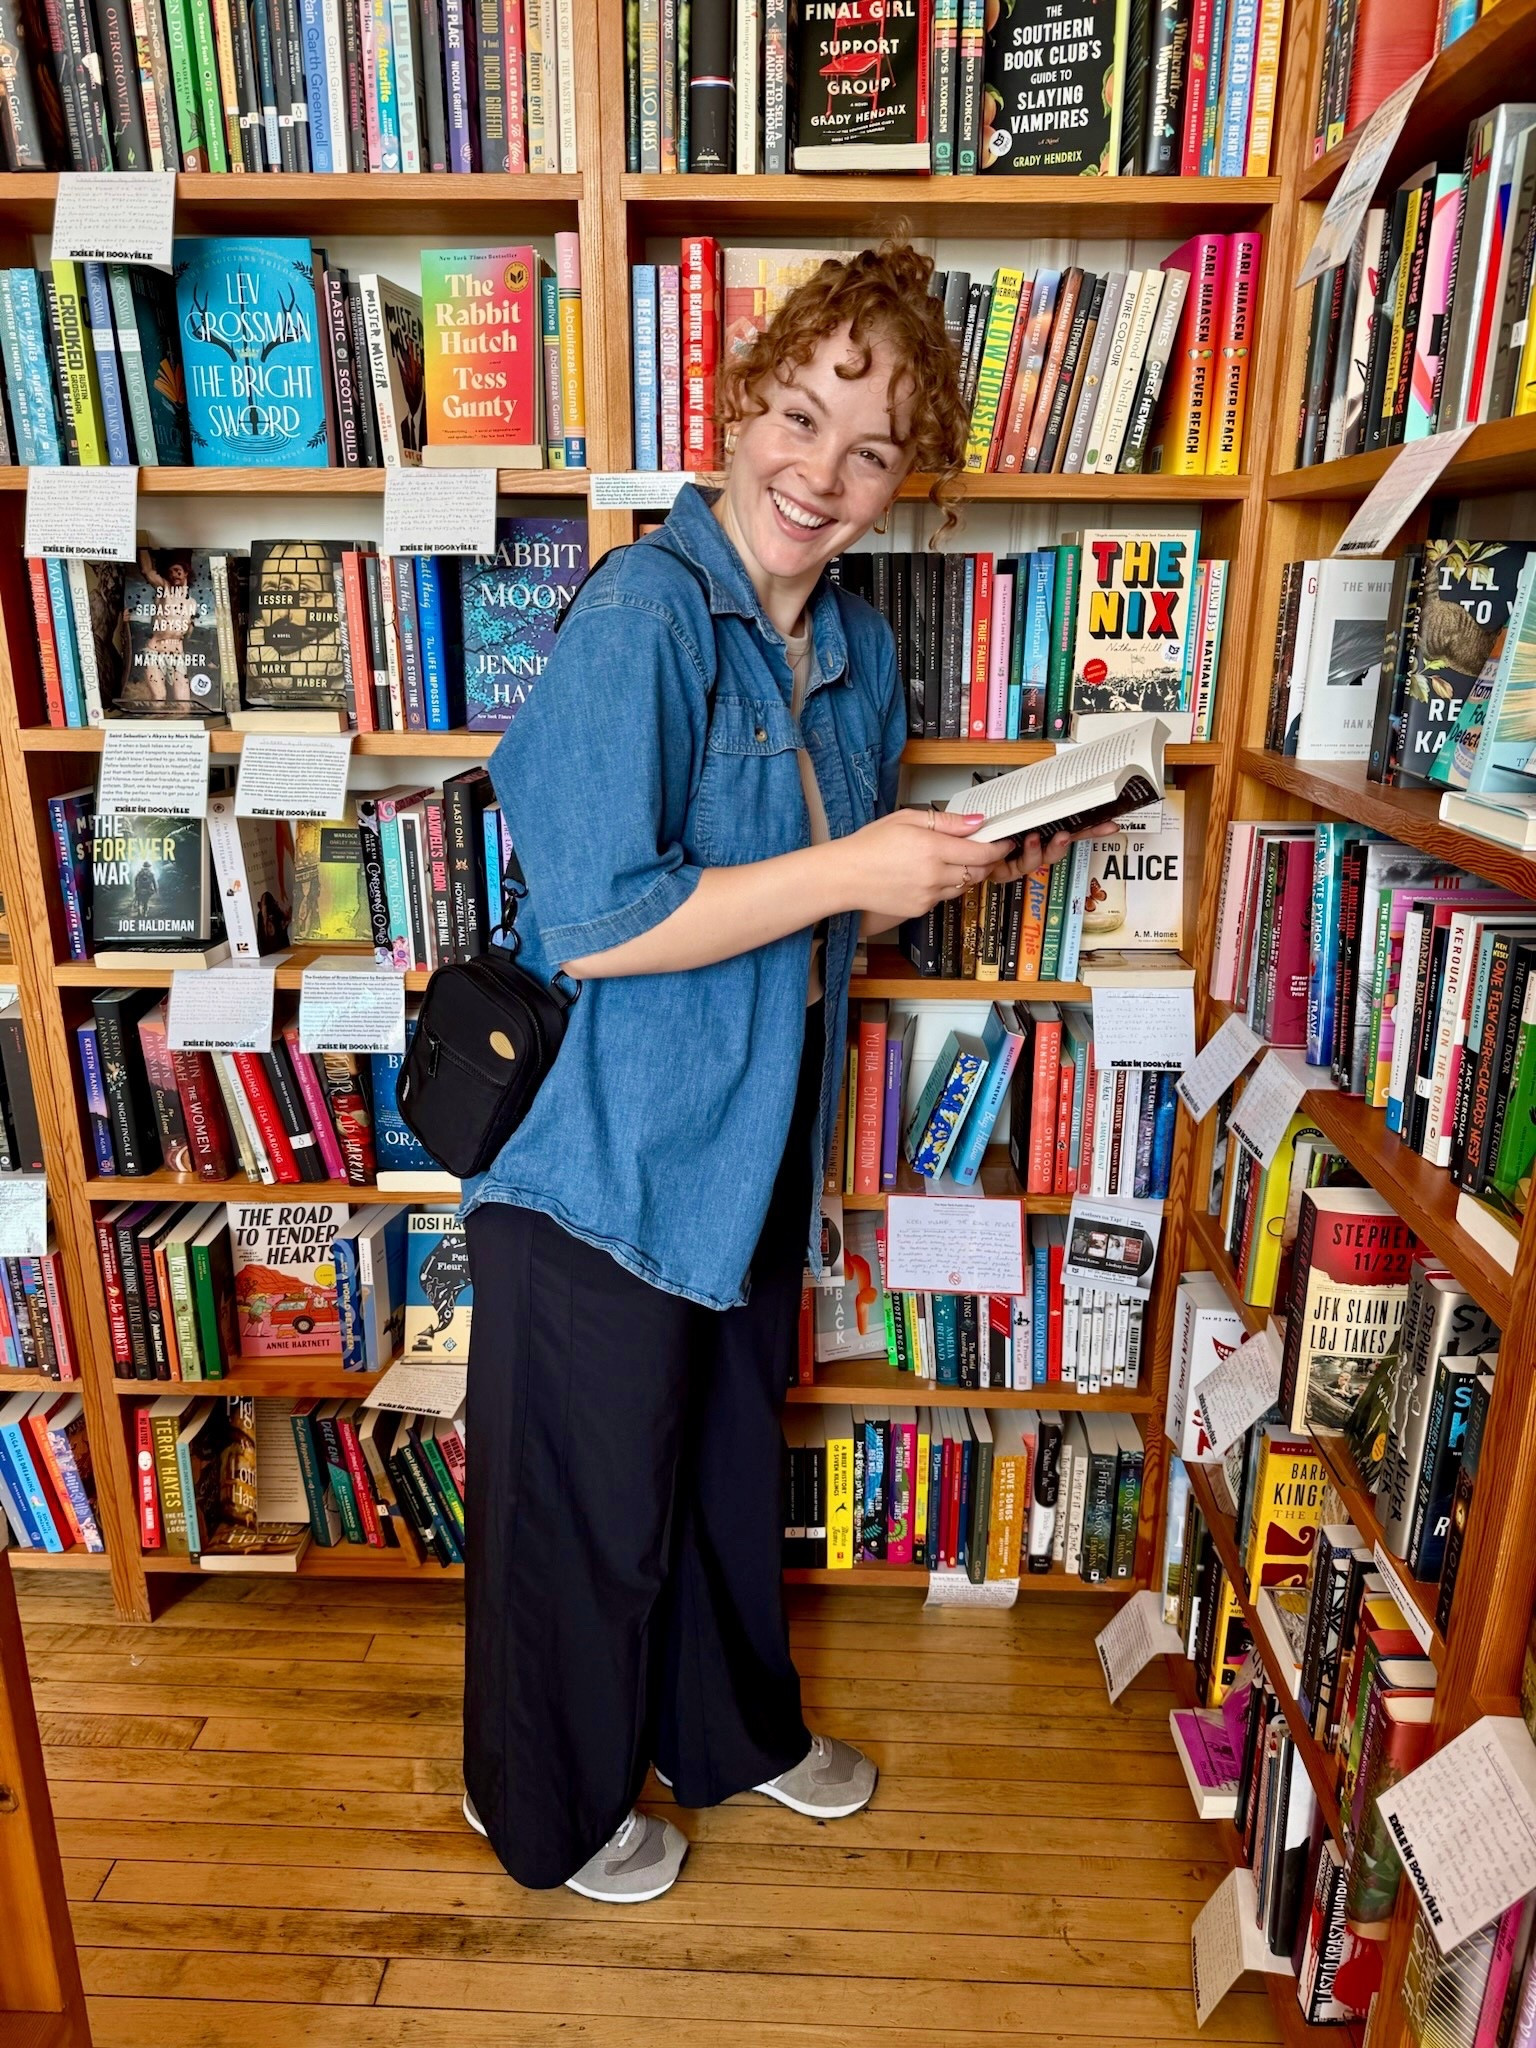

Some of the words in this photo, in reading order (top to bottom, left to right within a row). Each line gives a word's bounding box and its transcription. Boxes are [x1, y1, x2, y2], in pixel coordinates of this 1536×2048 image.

[805, 4, 862, 21] FINAL
[869, 1, 916, 18] GIRL
[1046, 5, 1063, 17] THE
[642, 22, 657, 41] THE
[1013, 16, 1095, 47] SOUTHERN
[308, 27, 320, 68] Garth
[642, 47, 657, 73] SUN
[819, 39, 899, 56] SUPPORT
[1004, 46, 1043, 71] BOOK
[1049, 39, 1102, 65] CLUB'S
[106, 7, 131, 125] OVERGROWTH
[767, 45, 776, 105] HAUNTED
[776, 54, 784, 80] HOW
[1031, 71, 1057, 85] GUIDE
[1060, 69, 1072, 82] TO
[642, 77, 657, 116] ALSO
[776, 83, 784, 99] TO
[826, 78, 891, 96] GROUP
[1017, 85, 1083, 111] SLAYING
[310, 70, 328, 148] Greenwell
[775, 105, 784, 129] SELL
[810, 113, 850, 127] GRADY
[855, 104, 906, 124] HENDRIX
[1010, 108, 1089, 135] VAMPIRES
[642, 120, 657, 151] RISES
[766, 108, 776, 149] HOUSE
[1013, 154, 1041, 168] GRADY
[1044, 150, 1082, 165] HENDRIX
[689, 243, 702, 272] GREAT
[1238, 242, 1253, 279] CARL
[226, 272, 260, 305] LEV
[444, 274, 494, 298] The
[689, 274, 702, 290] BIG
[1170, 278, 1182, 296] NO
[330, 280, 346, 342] PLASTIC
[434, 300, 522, 327] Rabbit
[689, 292, 702, 340] BEAUTIFUL
[1157, 299, 1179, 347] NAMES
[1231, 281, 1249, 342] HIAASEN
[59, 294, 84, 370] CROOKED
[184, 311, 311, 343] GROSSMAN
[985, 301, 1016, 363] SLOW
[440, 331, 518, 356] Hutch
[690, 344, 703, 363] LIFE
[192, 366, 224, 398] THE
[232, 365, 313, 399] BRIGHT
[452, 367, 507, 390] Tess
[1146, 360, 1162, 394] GREG
[1226, 364, 1241, 407] FEVER
[339, 368, 353, 416] SCOTT
[689, 377, 703, 411] EMILY
[442, 394, 518, 423] Gunty
[968, 366, 1003, 447] HORSES
[208, 405, 300, 438] SWORD
[689, 415, 704, 451] HENRY
[1131, 395, 1154, 448] HEWETT
[1220, 410, 1237, 453] BEACH
[344, 420, 358, 462] GUILD
[474, 542, 582, 568] RABBIT
[1092, 541, 1187, 588] THE
[156, 586, 190, 599] SAINT
[1342, 581, 1364, 592] THE
[1438, 567, 1500, 590] I'LL
[136, 604, 208, 616] SEBASTIAN'S
[258, 595, 293, 606] LESSER
[481, 584, 576, 609] MOON
[1207, 568, 1222, 632] WELLNESS
[73, 587, 90, 641] STEPHEN
[152, 620, 189, 632] ABYSS
[309, 612, 339, 622] RUINS
[1089, 591, 1179, 639] NIX
[404, 633, 413, 651] HOW
[81, 643, 97, 692] FLORIDA
[134, 654, 166, 667] MARK
[168, 654, 206, 667] HABER
[261, 664, 286, 674] MARK
[406, 654, 415, 664] TO
[1202, 640, 1213, 688] NATHAN
[296, 678, 328, 688] HABER
[407, 666, 417, 686] STOP
[409, 689, 419, 707] TIME
[1198, 688, 1208, 718] HILL
[1343, 719, 1364, 729] HAN
[93, 815, 124, 837] THE
[427, 806, 443, 858] MAXWELL'S
[92, 838, 176, 862] FOREVER
[1102, 842, 1121, 852] END
[1133, 842, 1145, 852] OF
[1319, 833, 1328, 854] THE
[93, 862, 130, 886] WAR
[431, 861, 447, 892] DEMON
[1103, 855, 1178, 881] ALICE
[1315, 858, 1326, 899] WHYTE
[118, 920, 136, 932] JOE
[138, 919, 194, 932] HALDEMAN
[436, 900, 448, 928] STEVEN
[989, 892, 998, 932] PRACTICAL
[440, 929, 449, 946] HALL
[1134, 930, 1141, 938] A.
[1143, 930, 1151, 938] M.
[1154, 930, 1178, 939] Homes
[1313, 904, 1324, 952] PYTHON
[987, 933, 995, 958] MAGIC
[1448, 927, 1464, 994] KEROUAC
[865, 1033, 880, 1047] YU
[1440, 1029, 1450, 1045] ON
[84, 1038, 95, 1070] KRISTIN
[864, 1051, 878, 1072] HUA
[1435, 1054, 1447, 1080] THE
[89, 1072, 101, 1108] HANNAH
[863, 1087, 877, 1109] CITY
[1431, 1085, 1443, 1123] ROAD
[117, 1102, 133, 1157] NIGHTINGALE
[190, 1102, 212, 1154] WOMEN
[257, 1105, 269, 1124] LISA
[264, 1126, 284, 1163] HARDING
[862, 1114, 877, 1127] OF
[861, 1130, 876, 1169] FICTION
[239, 1208, 272, 1226] THE
[278, 1206, 333, 1224] ROAD
[412, 1218, 440, 1230] IOSI
[236, 1228, 259, 1246] TO
[266, 1225, 339, 1246] TENDER
[266, 1245, 335, 1264] HEARTS
[437, 1262, 462, 1271] Fleur
[170, 1256, 188, 1300] WEYWARD
[1313, 1296, 1341, 1320] JFK
[1346, 1299, 1388, 1324] SLAIN
[1179, 1302, 1191, 1356] STEPHEN
[1310, 1325, 1337, 1351] LBJ
[1343, 1328, 1386, 1354] TAKES
[1412, 1303, 1436, 1376] STEPHEN
[266, 1340, 290, 1350] ANNIE
[292, 1339, 330, 1348] HARTNETT
[1177, 1358, 1187, 1389] KING
[156, 1419, 173, 1463] TERRY
[162, 1465, 181, 1508] HAYES
[1097, 1471, 1110, 1497] FIFTH
[1123, 1478, 1136, 1513] STONE
[1094, 1498, 1107, 1535] SEASON
[1121, 1513, 1134, 1532] SKY
[1316, 1954, 1340, 2003] LÁSZLÓ
